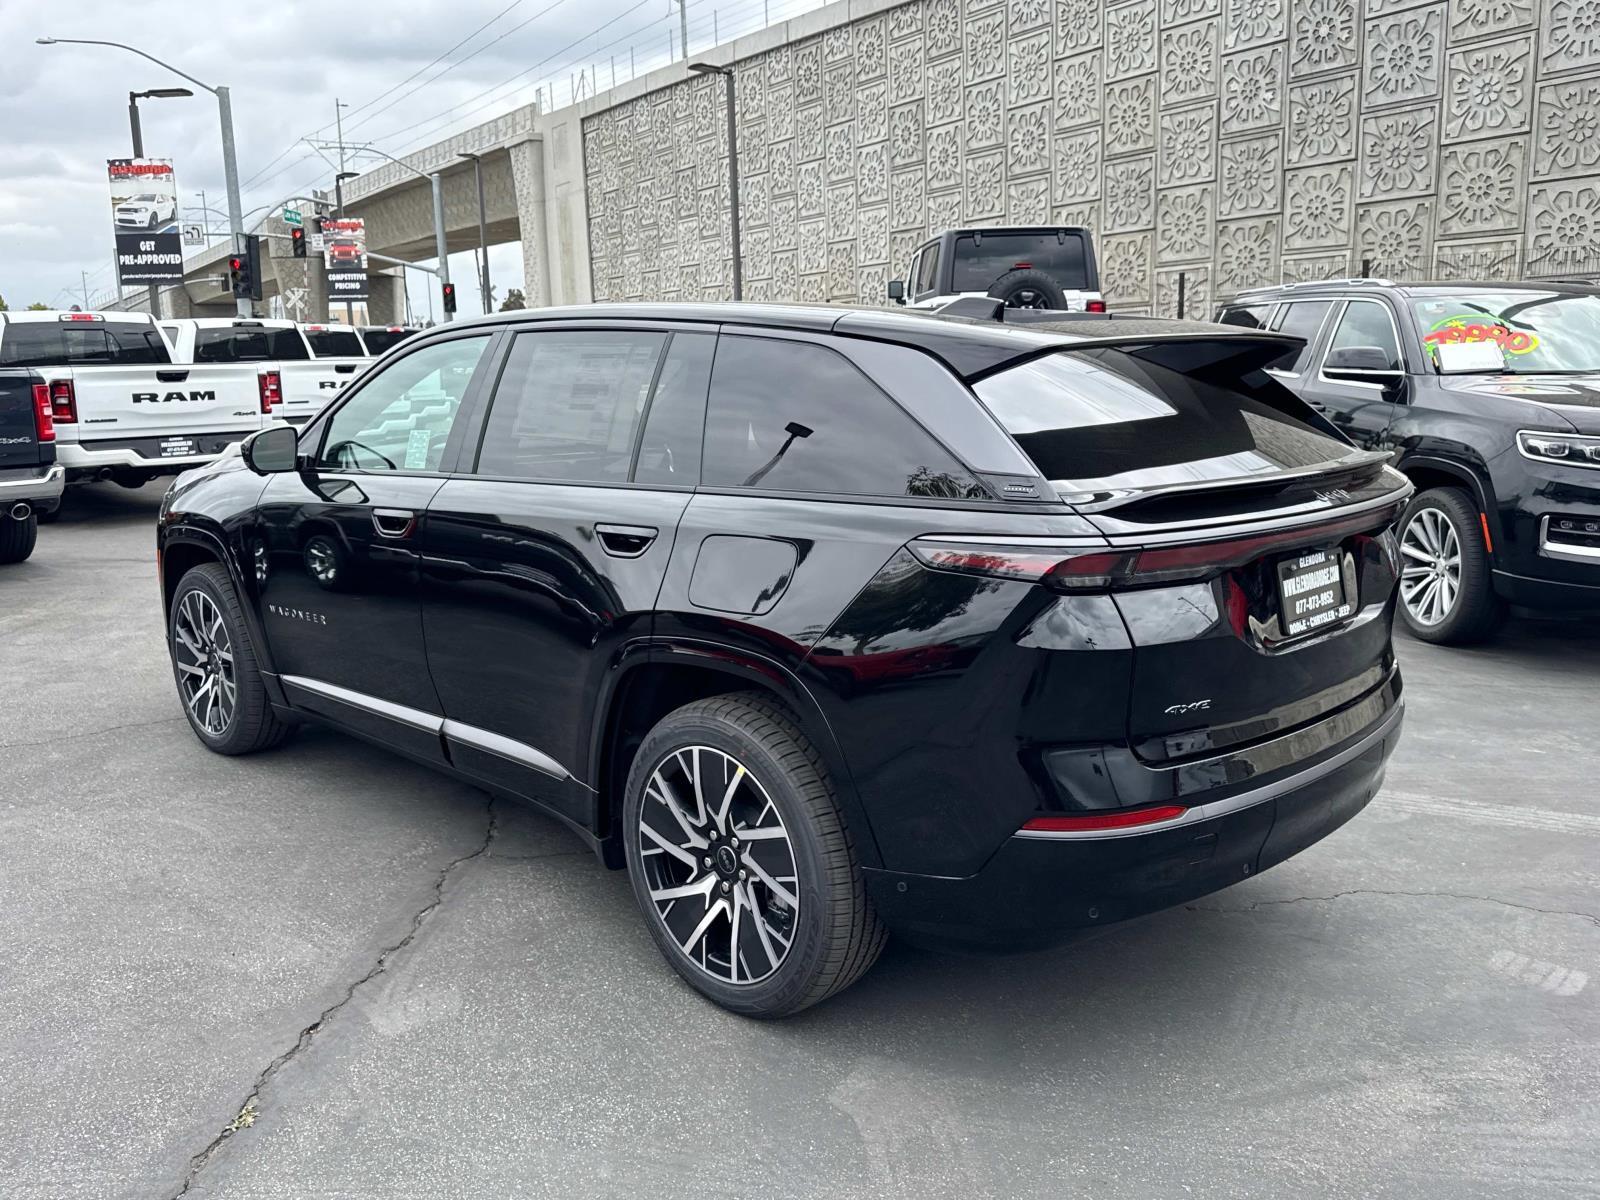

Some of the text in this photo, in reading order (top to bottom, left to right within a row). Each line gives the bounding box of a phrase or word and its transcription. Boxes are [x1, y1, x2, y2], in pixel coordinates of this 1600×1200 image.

[139, 240, 156, 252] GET
[119, 253, 182, 266] PRE-APPROVED
[328, 273, 367, 281] COMPETITIVE
[334, 282, 361, 290] PRICING
[131, 390, 216, 404] RAM
[1299, 551, 1326, 569] GLENDORA
[268, 603, 327, 626] WAGONEER
[1289, 604, 1351, 635] DODGE CHRYSLER JEEP
